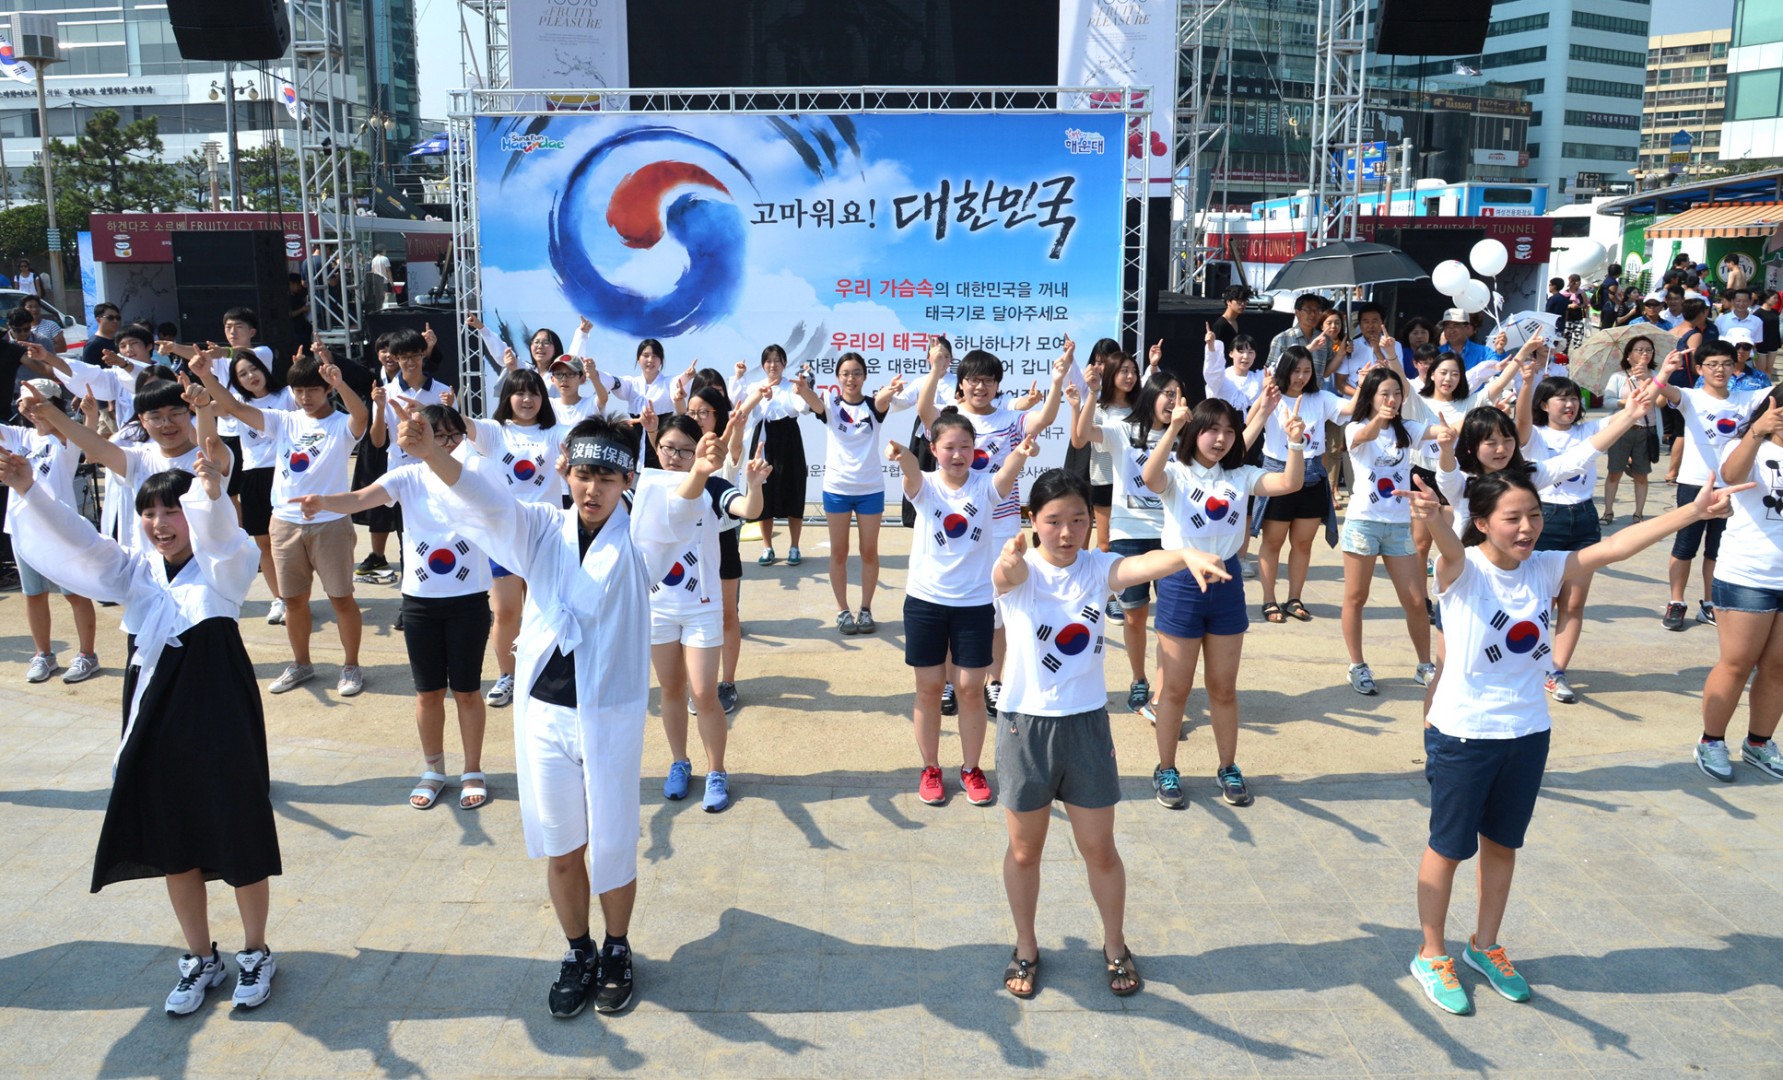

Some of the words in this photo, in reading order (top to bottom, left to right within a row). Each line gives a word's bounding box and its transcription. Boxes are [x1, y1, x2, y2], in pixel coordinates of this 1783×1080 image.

[538, 16, 602, 29] PLEASURE
[1087, 14, 1151, 28] PLEASURE
[1270, 103, 1278, 136] KOREAN
[1065, 140, 1104, 153] 해운대
[106, 221, 149, 232] 하겐다즈
[154, 221, 187, 232] 소르베
[190, 221, 230, 231] FRUITY
[234, 221, 254, 231] ICY
[258, 221, 305, 231] TUNNEL
[750, 198, 876, 229] 고마워요!
[894, 176, 1076, 260] 대한민국
[1492, 224, 1537, 234] TUNNEL
[1250, 239, 1263, 256] ICY
[1265, 238, 1295, 257] TUNNEL
[836, 279, 871, 297] 우리
[881, 279, 949, 298] 가슴속의
[956, 281, 1032, 298] 대한민국을
[1038, 281, 1068, 298] 꺼내
[925, 305, 986, 321] 태극기로
[992, 305, 1069, 322] 달아주세요
[831, 332, 885, 351] 우리의
[954, 335, 1031, 351] 하나하나가
[807, 358, 881, 375] 자랑운
[888, 358, 960, 375] 대한민을
[1021, 359, 1053, 375] 갑니
